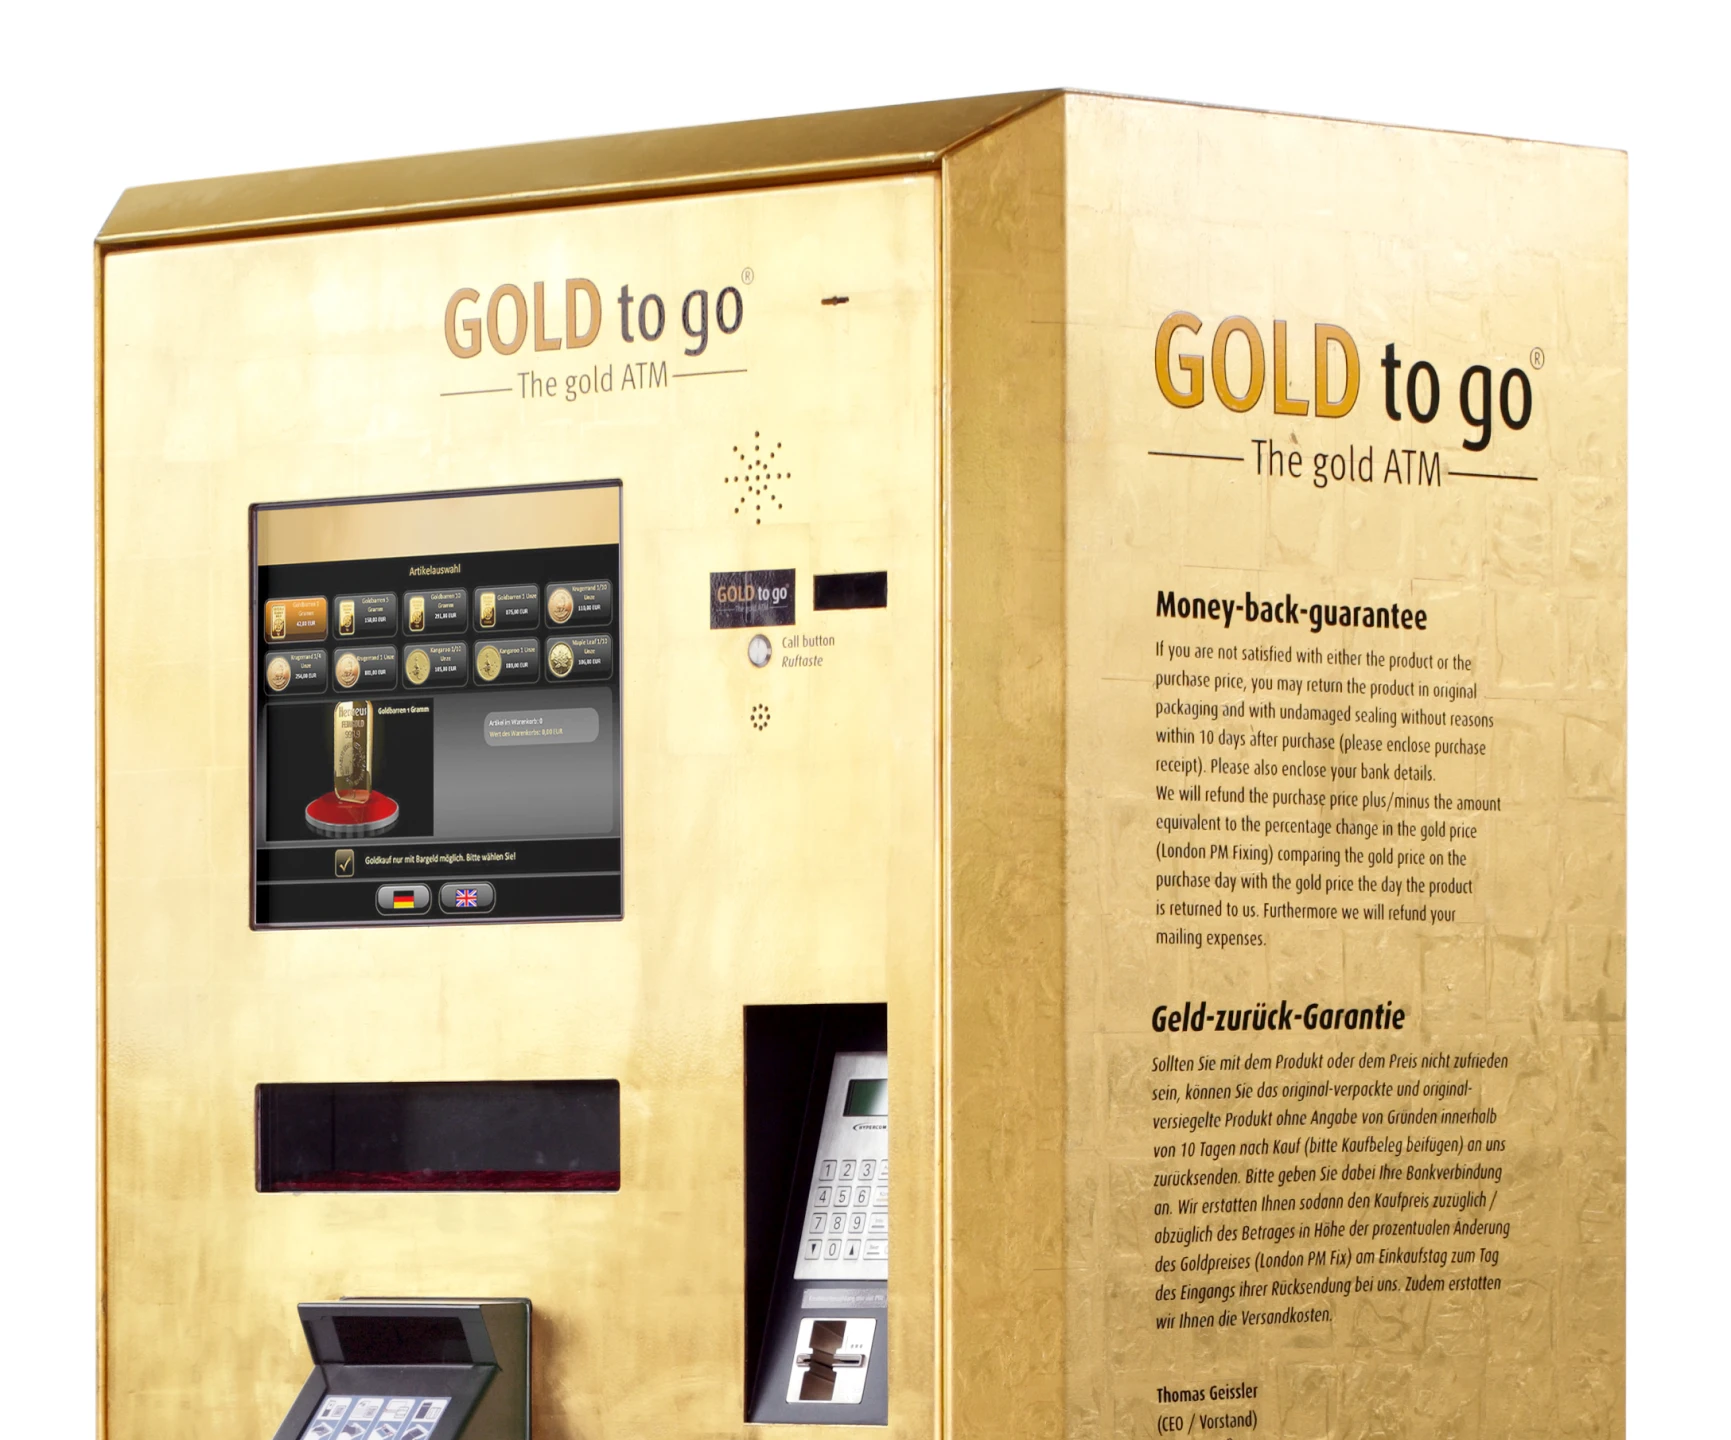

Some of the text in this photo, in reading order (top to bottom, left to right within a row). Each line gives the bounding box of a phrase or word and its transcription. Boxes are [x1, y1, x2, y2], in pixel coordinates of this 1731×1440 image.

[444, 278, 602, 358] GOLD
[617, 284, 665, 342] to
[1154, 310, 1361, 418] GOLD
[1380, 342, 1440, 423] to
[518, 360, 668, 402] The gold ATM
[1251, 438, 1442, 488] The gold ATM
[408, 564, 461, 576] Artikelauswahl
[717, 584, 755, 603] GOLD
[758, 586, 770, 600] to
[1157, 591, 1427, 633] Money-back-guarantee
[782, 635, 835, 648] Call button
[782, 654, 824, 668] Ruftaste
[1156, 640, 1471, 671] If you are not satisfied with either the product or the
[378, 707, 406, 715] Goldbarren
[365, 855, 392, 865] Goldkauf
[404, 855, 415, 863] mit
[416, 854, 439, 865] Bargeld
[440, 853, 465, 864] möglich.
[466, 853, 480, 862] Bitte
[482, 852, 504, 861] wählen
[504, 852, 517, 861] Sie!
[1156, 928, 1266, 949] mailing expenses.
[1152, 1000, 1405, 1032] Geld-zurück-Garantie
[1152, 1052, 1508, 1072] Sollten Sie mit dem Produkt oder dem Preis nicht zufrieden
[825, 1164, 871, 1177] 1 2 3
[819, 1190, 866, 1203] 4 5 6
[815, 1217, 822, 1229] 7
[833, 1217, 841, 1230] 8
[853, 1216, 861, 1230] 9
[829, 1243, 836, 1256] 0
[1157, 1382, 1258, 1403] Thomas Geissler
